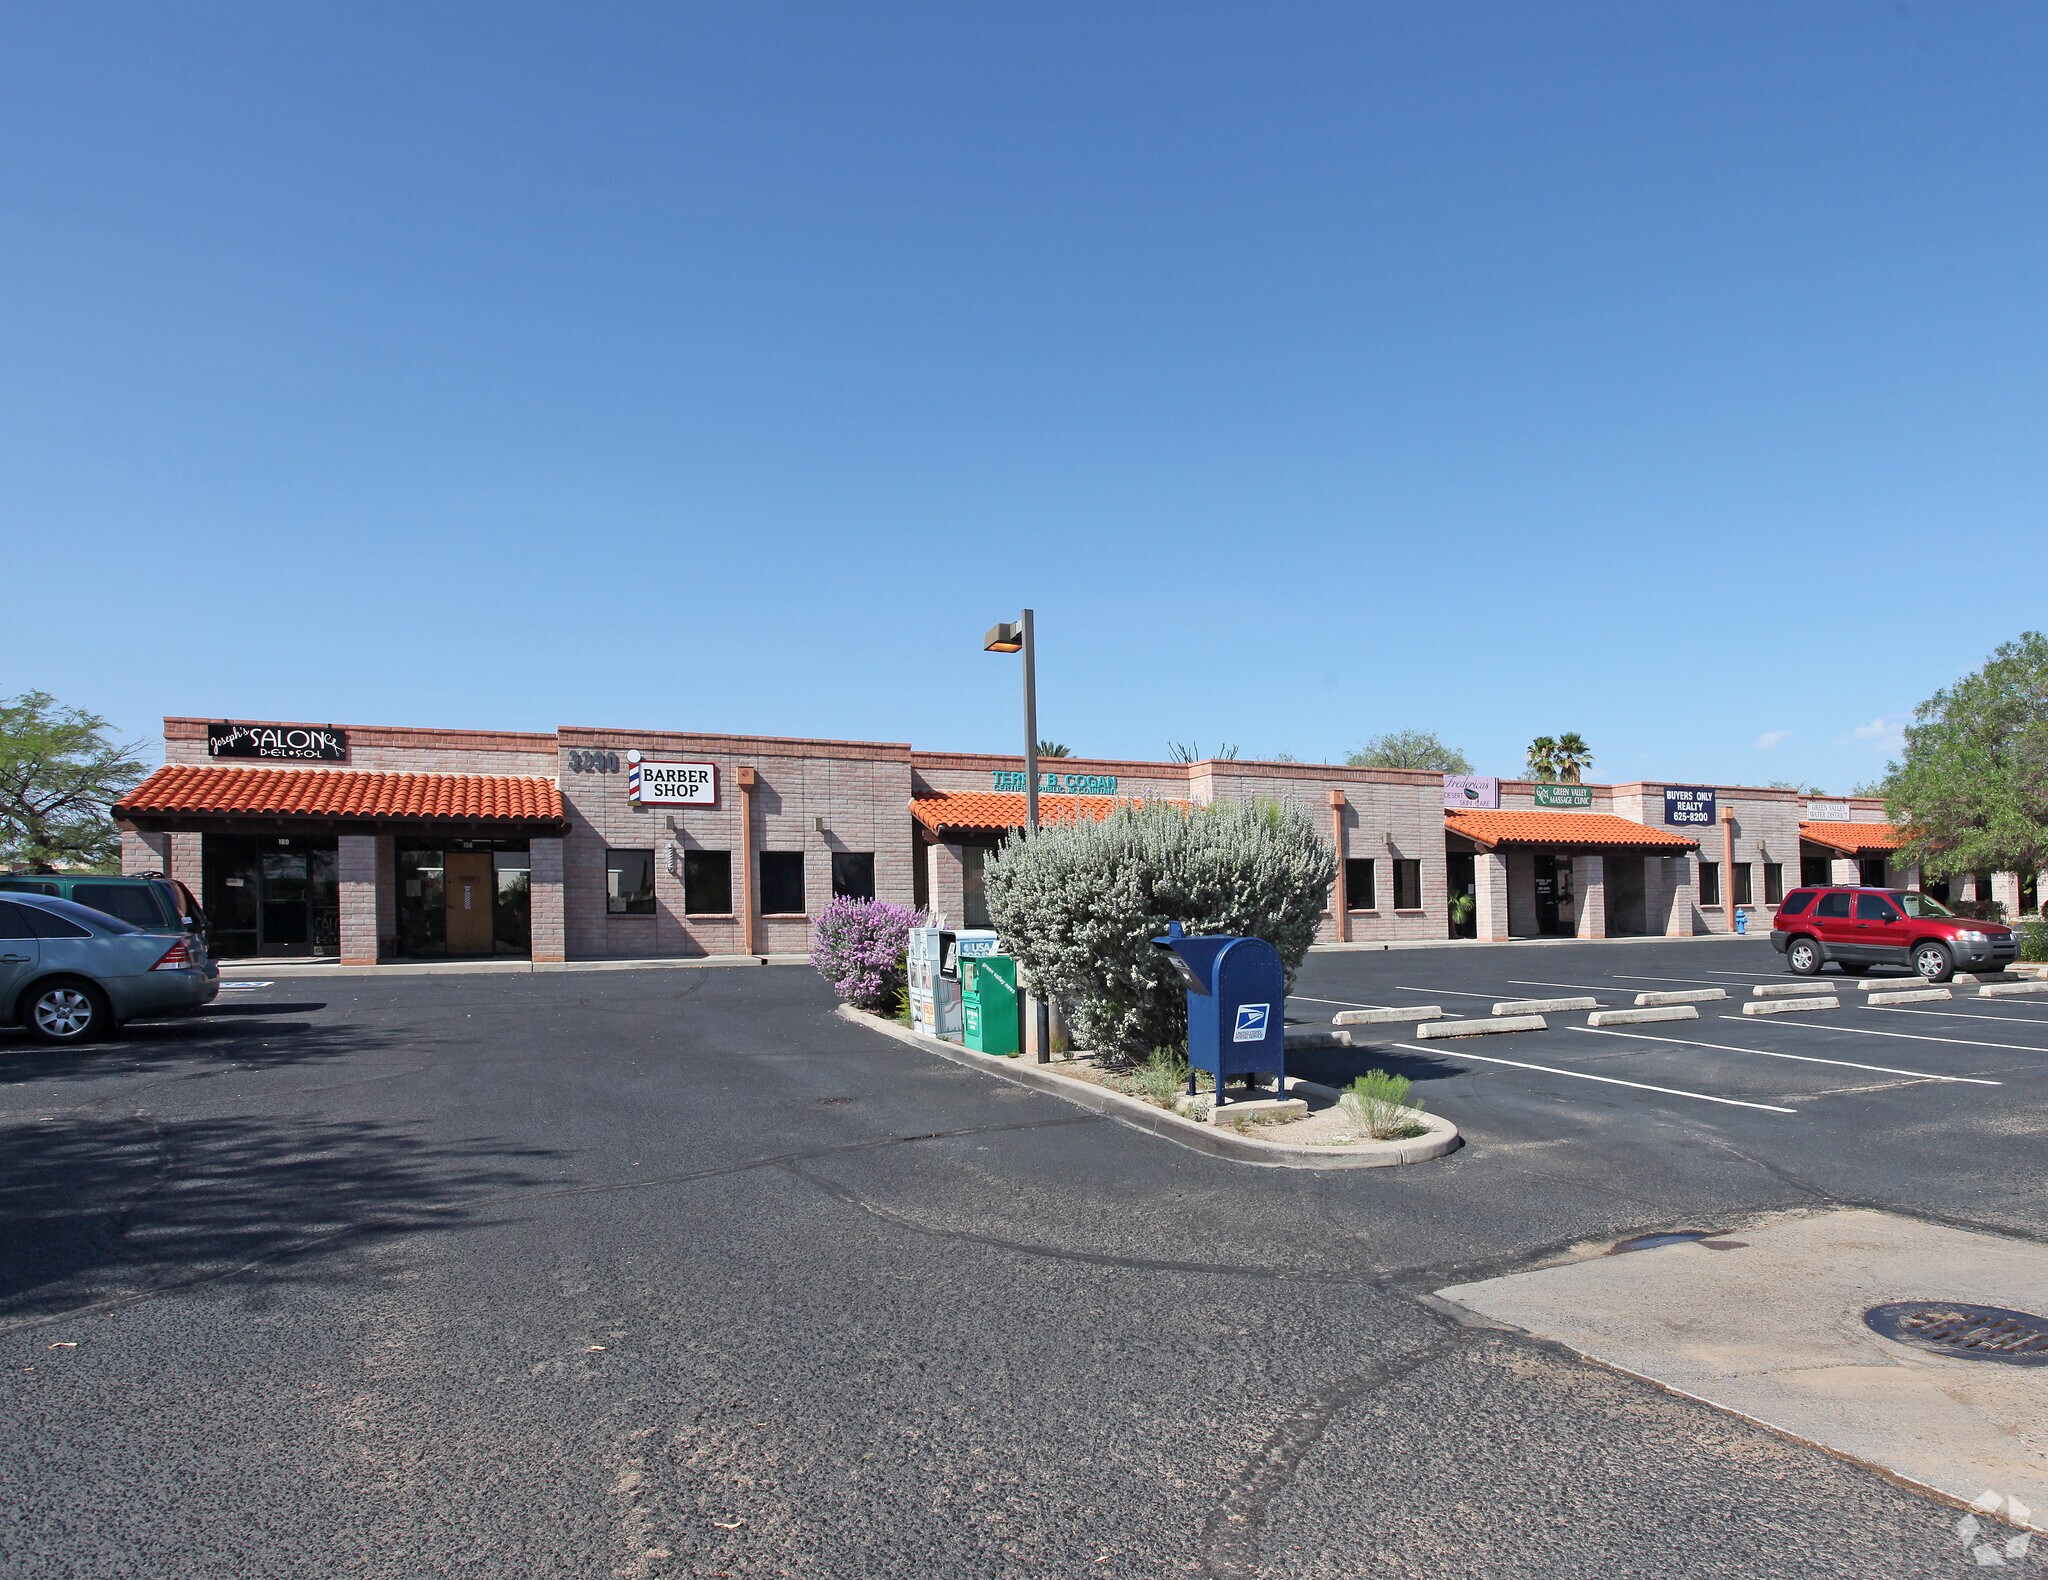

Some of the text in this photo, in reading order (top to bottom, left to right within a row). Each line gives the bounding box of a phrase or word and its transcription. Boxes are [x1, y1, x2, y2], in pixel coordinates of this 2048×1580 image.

[210, 726, 249, 755] Joseph's
[250, 728, 325, 749] SALON
[568, 750, 618, 772] 3290
[643, 768, 709, 783] BARBER
[1065, 774, 1117, 788] COGAN
[654, 784, 699, 797] SHOP
[1037, 785, 1065, 793] PUBLIC
[1553, 788, 1587, 797] GREEN VALLEY
[1550, 796, 1590, 805] MASSAGE CLINIC
[1666, 791, 1713, 801] BUYERS ONLY
[1677, 802, 1703, 811] REALTY
[1673, 812, 1708, 821] 625-8200
[972, 943, 990, 951] USA
